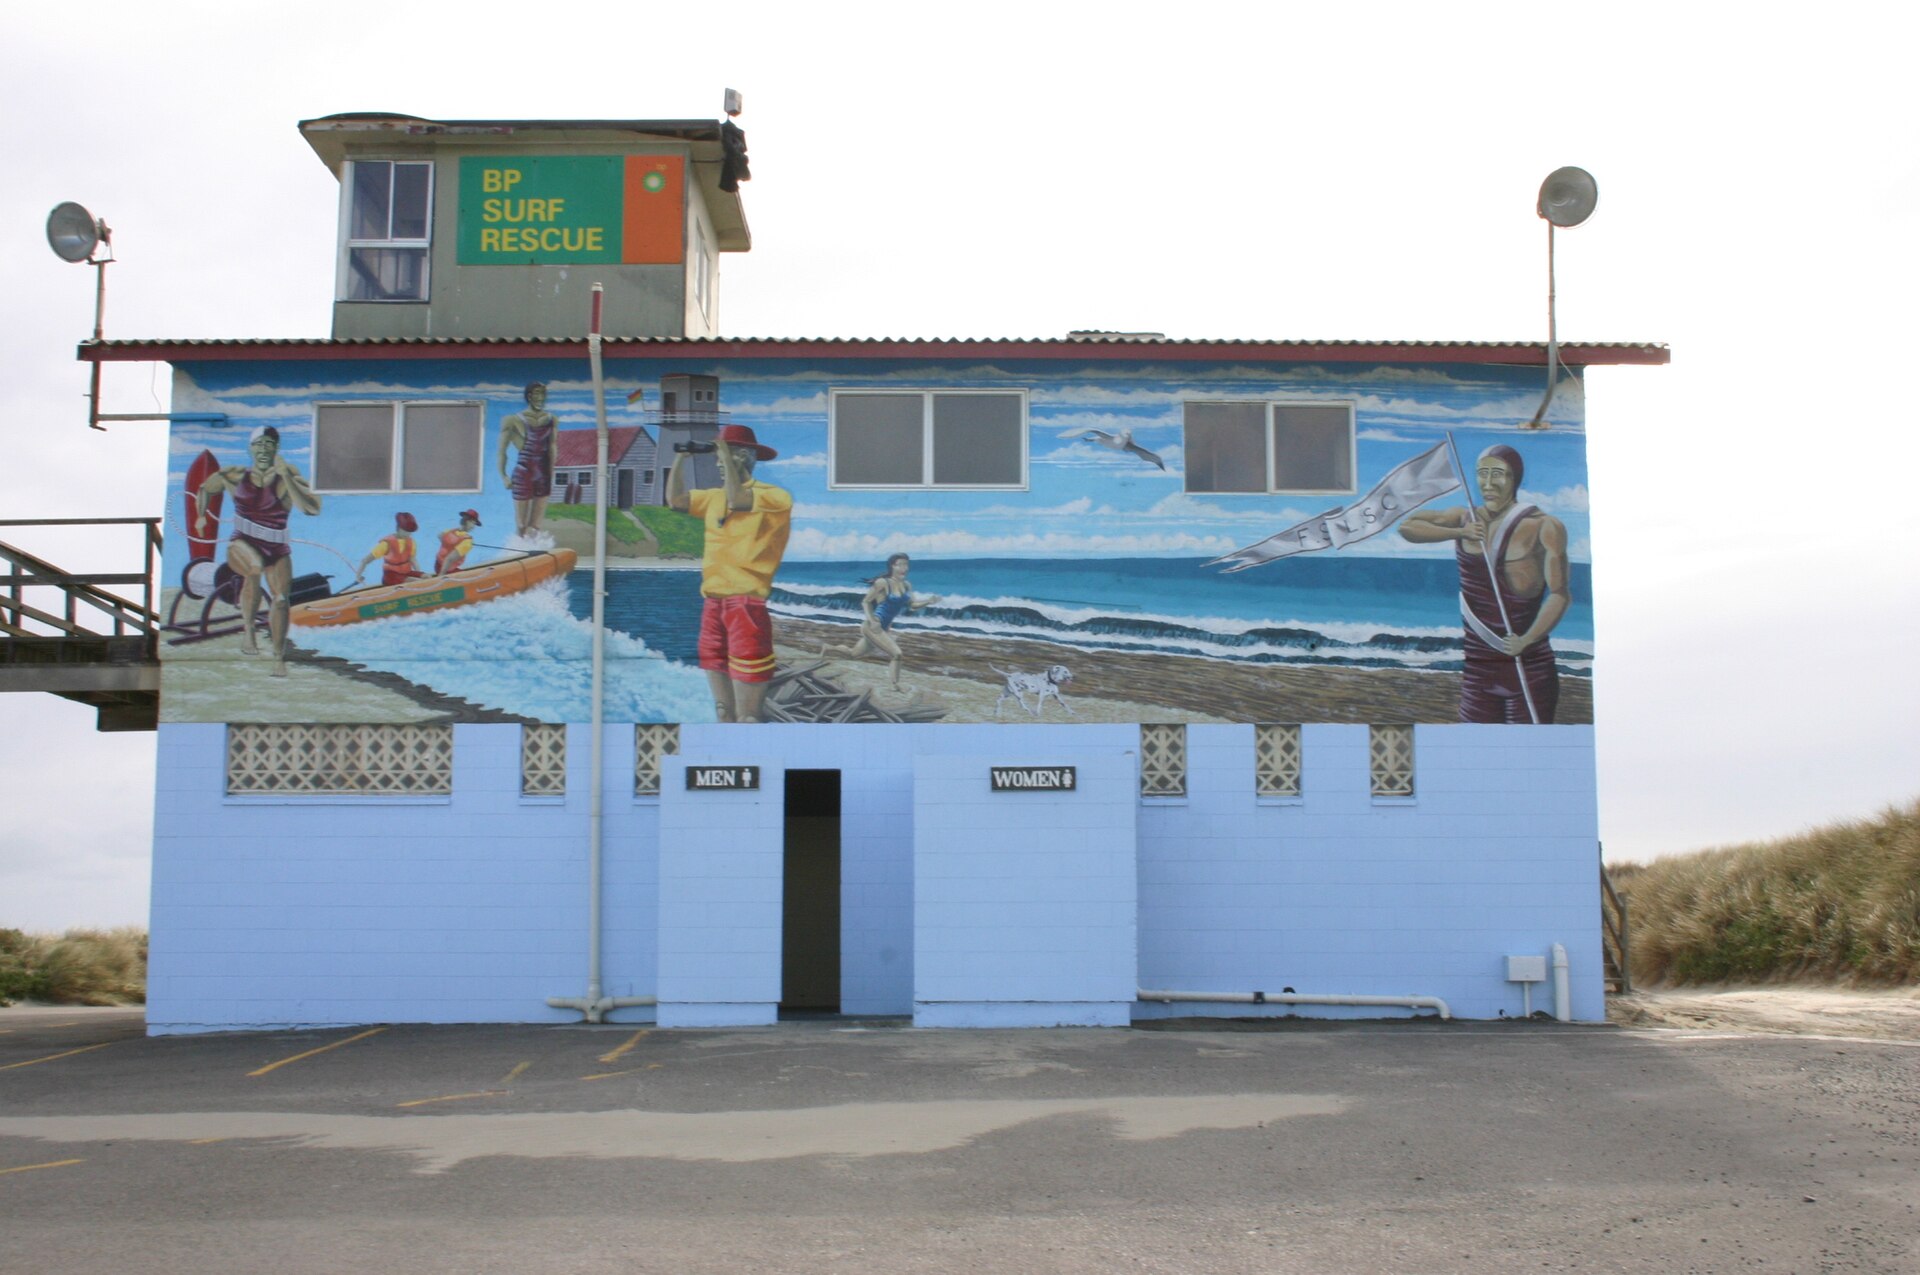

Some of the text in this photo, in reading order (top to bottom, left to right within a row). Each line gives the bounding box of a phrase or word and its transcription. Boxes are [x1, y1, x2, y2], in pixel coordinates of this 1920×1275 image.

[483, 169, 522, 193] BP
[482, 198, 565, 223] SURF
[481, 227, 604, 252] RESCUE
[695, 770, 736, 786] MEN
[993, 770, 1061, 787] WOMEN
